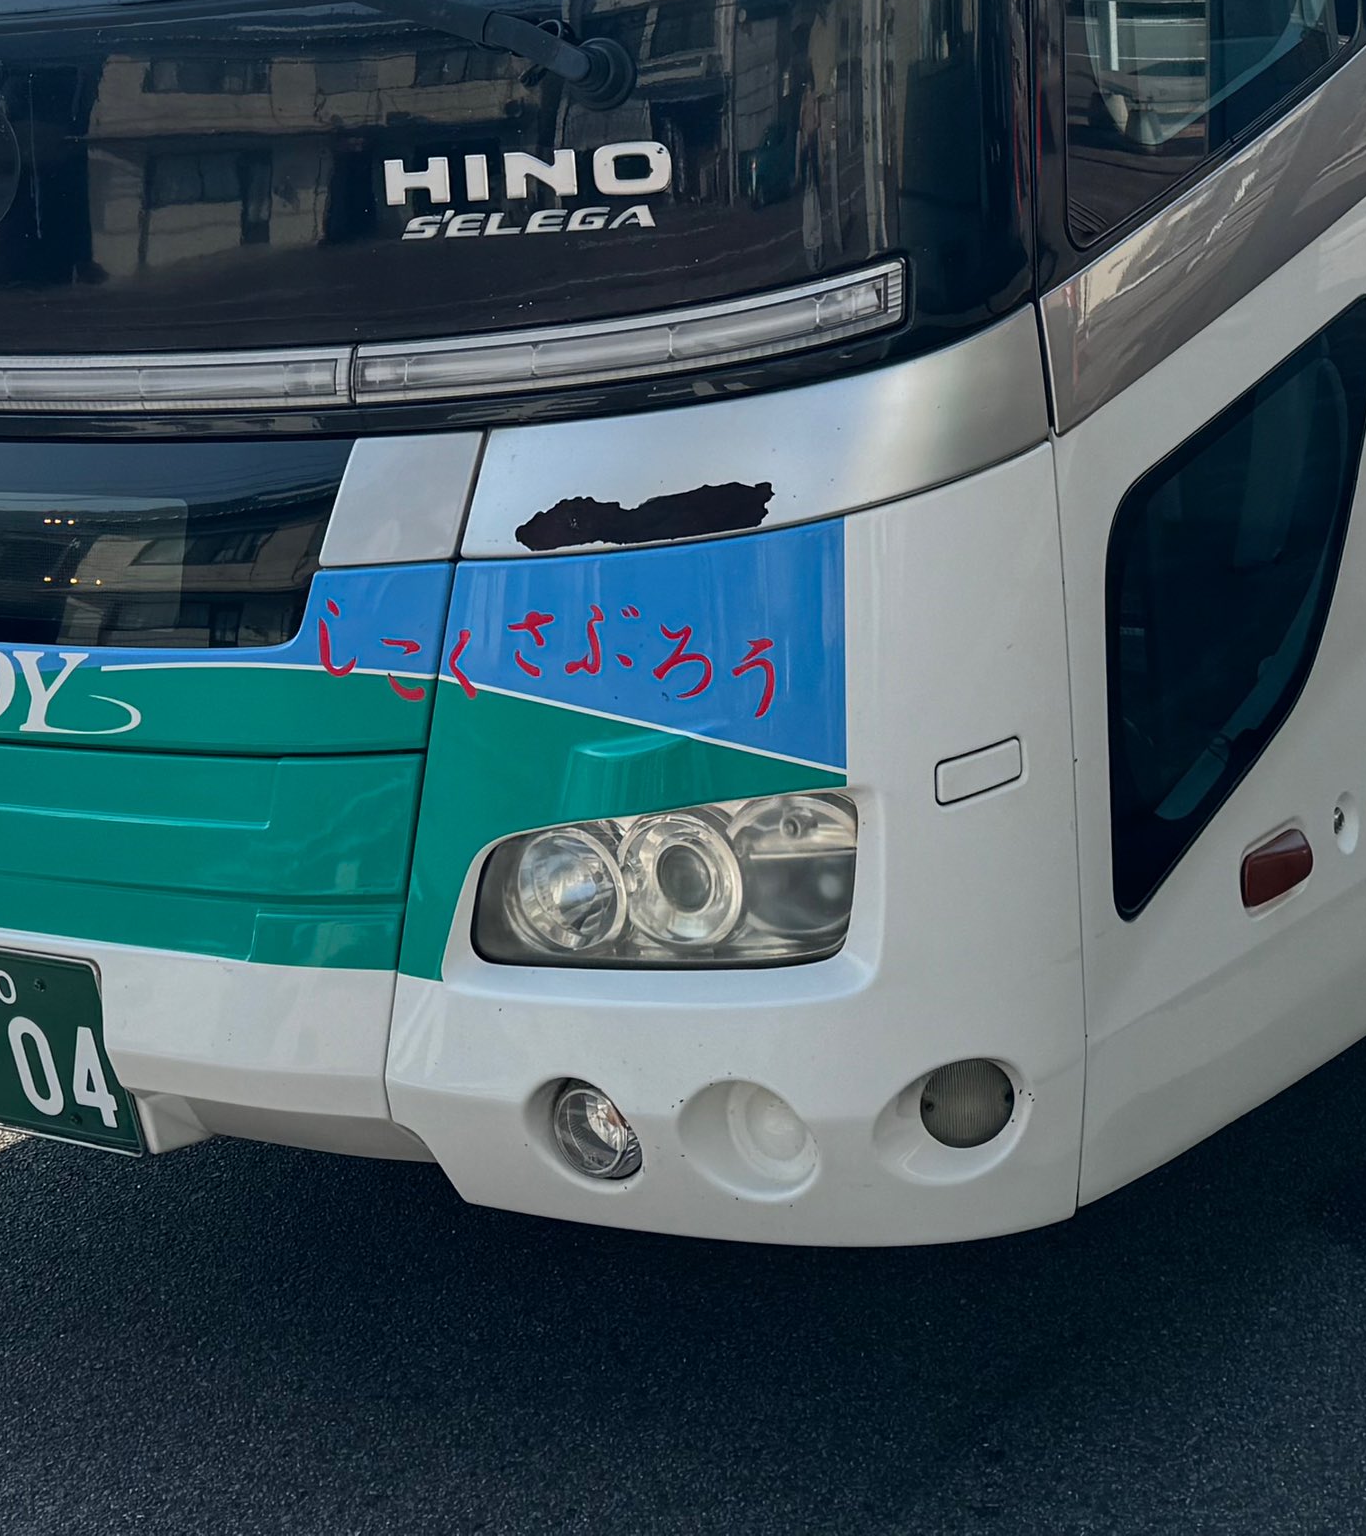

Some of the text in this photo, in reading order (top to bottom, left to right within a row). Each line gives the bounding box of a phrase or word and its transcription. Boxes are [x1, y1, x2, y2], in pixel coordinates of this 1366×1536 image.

[384, 141, 672, 206] HINO
[319, 598, 778, 718] しこくさぶろう
